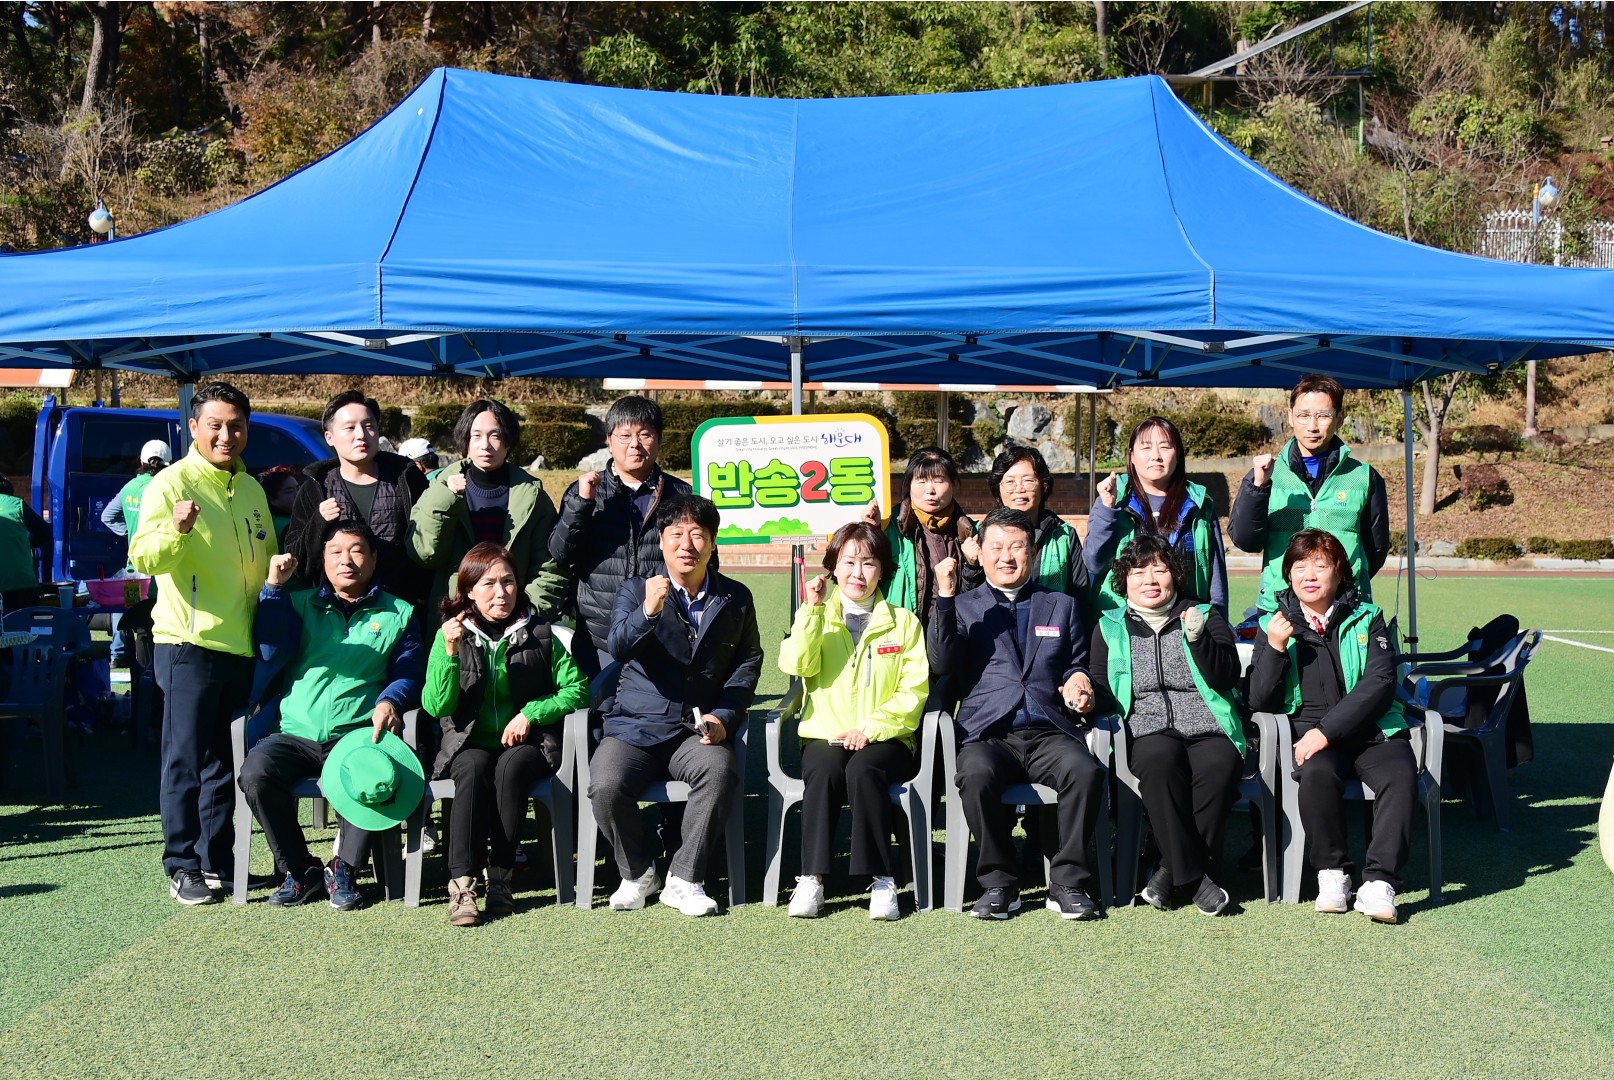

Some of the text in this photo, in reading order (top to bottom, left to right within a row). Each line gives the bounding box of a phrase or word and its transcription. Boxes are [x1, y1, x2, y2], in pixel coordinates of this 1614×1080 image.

[717, 438, 732, 447] 살기
[734, 437, 749, 447] 좋은
[751, 437, 768, 445] 도시,
[770, 436, 784, 444] 오고
[786, 435, 801, 445] 싶은
[803, 435, 818, 443] 도시
[707, 456, 876, 509] 반송2동
